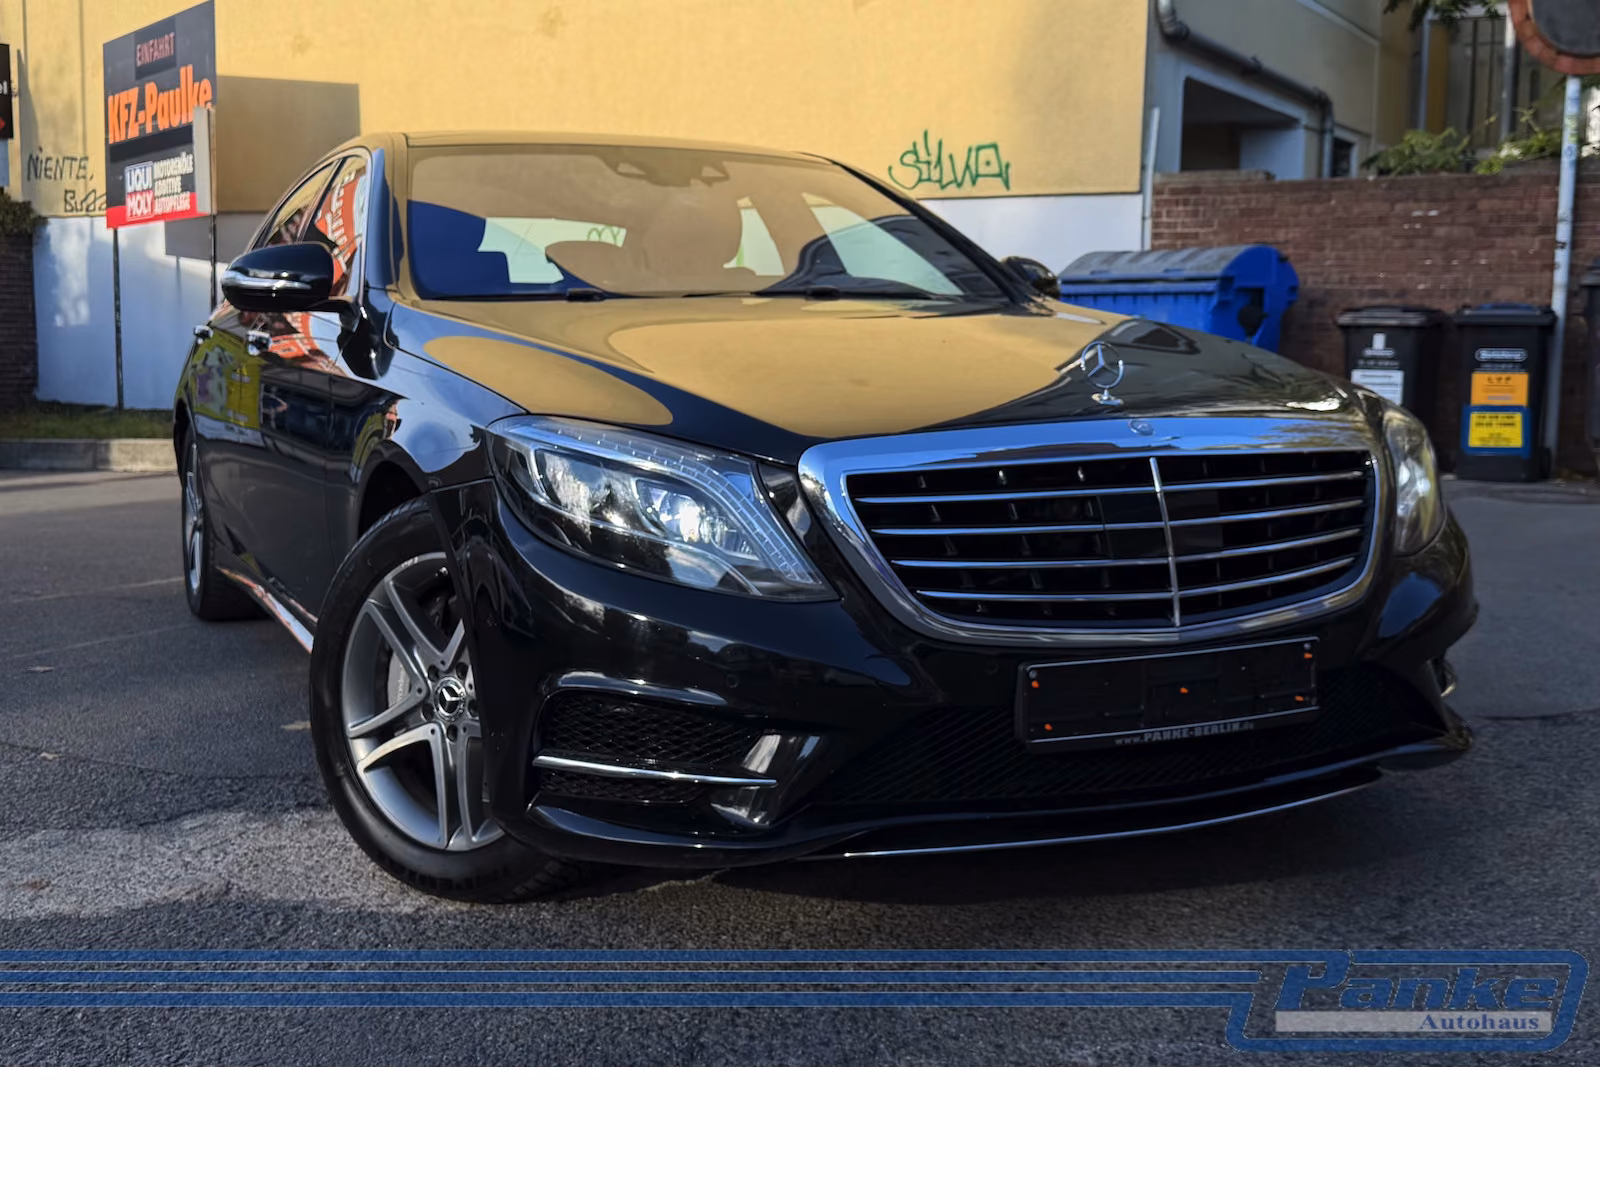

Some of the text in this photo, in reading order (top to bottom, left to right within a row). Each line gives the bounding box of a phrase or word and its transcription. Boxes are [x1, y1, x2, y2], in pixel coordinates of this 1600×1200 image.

[136, 32, 175, 67] EINFAHRT
[108, 64, 213, 145] KFZ-Paulke
[127, 166, 153, 192] LIQUI
[127, 190, 153, 218] MOLY
